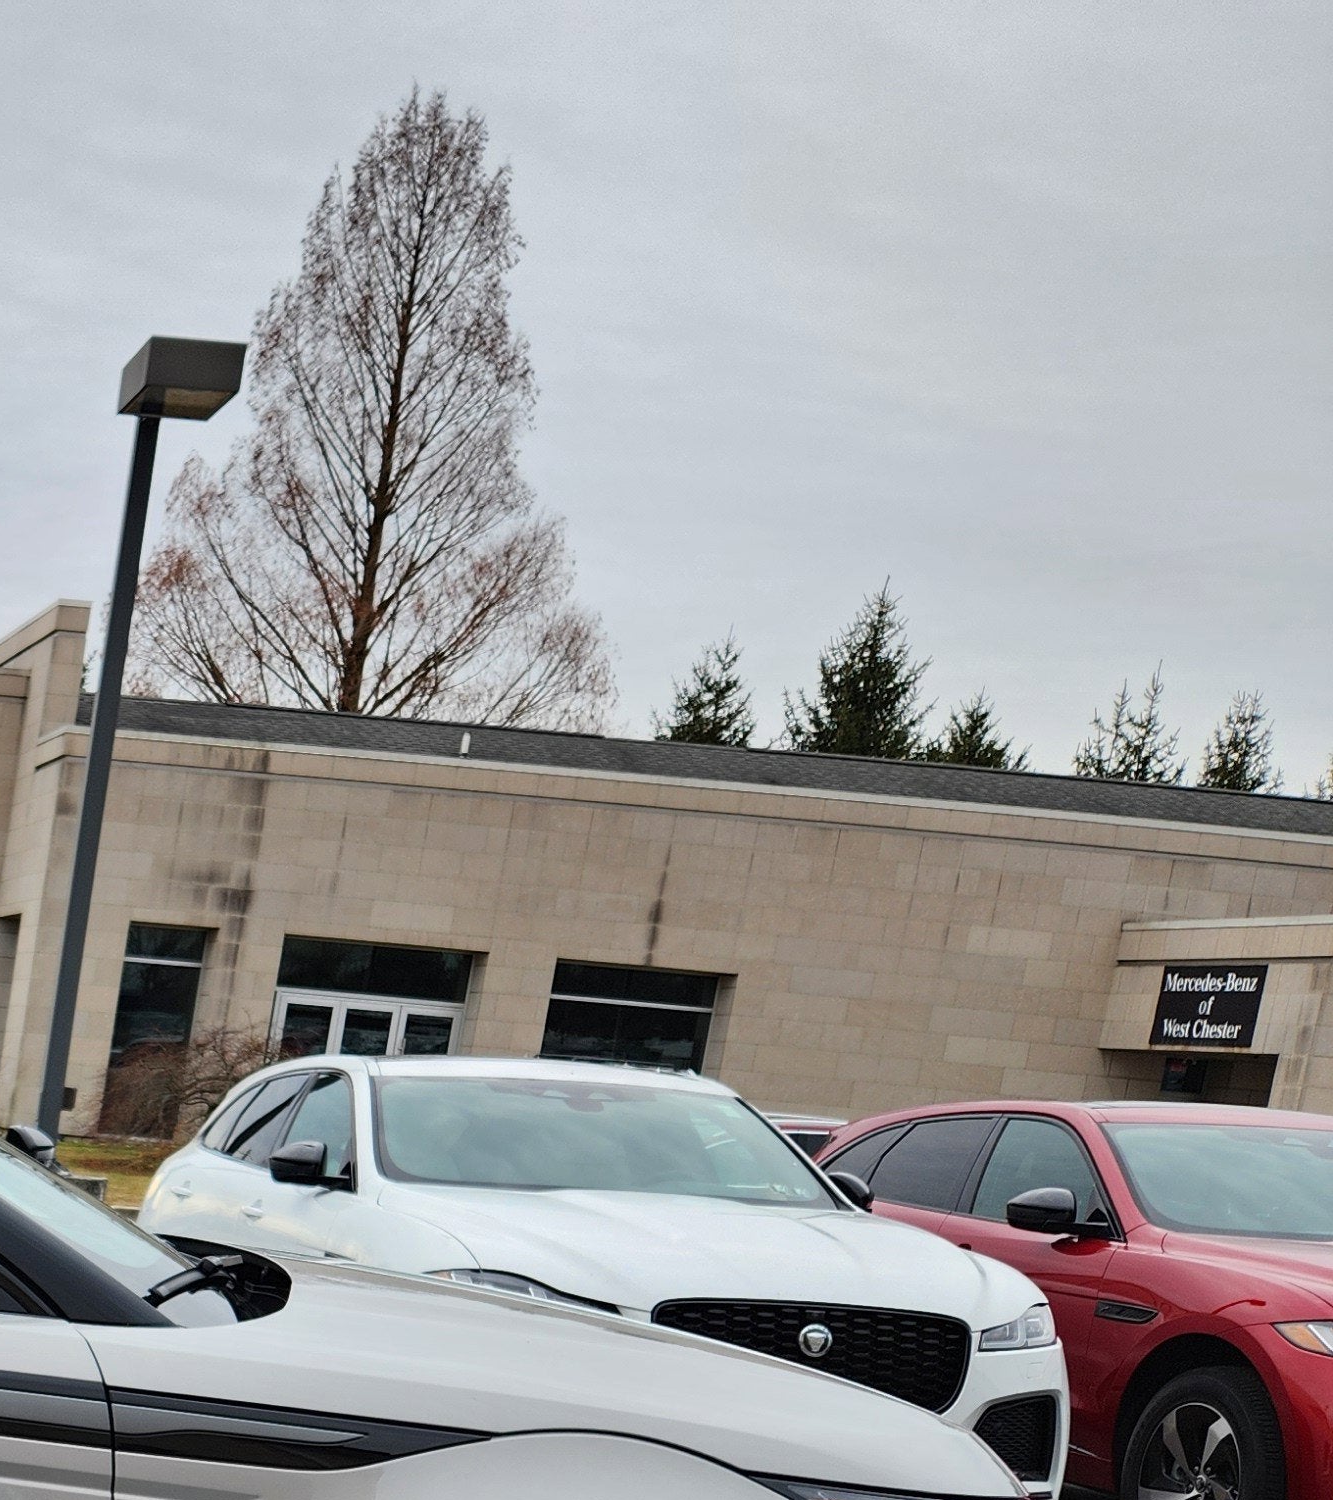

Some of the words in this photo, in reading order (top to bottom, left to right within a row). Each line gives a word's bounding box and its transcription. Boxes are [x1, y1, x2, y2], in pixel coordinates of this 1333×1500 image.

[1163, 972, 1258, 992] Mercedes-Benz
[1198, 995, 1215, 1015] of
[1163, 1018, 1191, 1038] West
[1192, 1018, 1242, 1039] Chester
